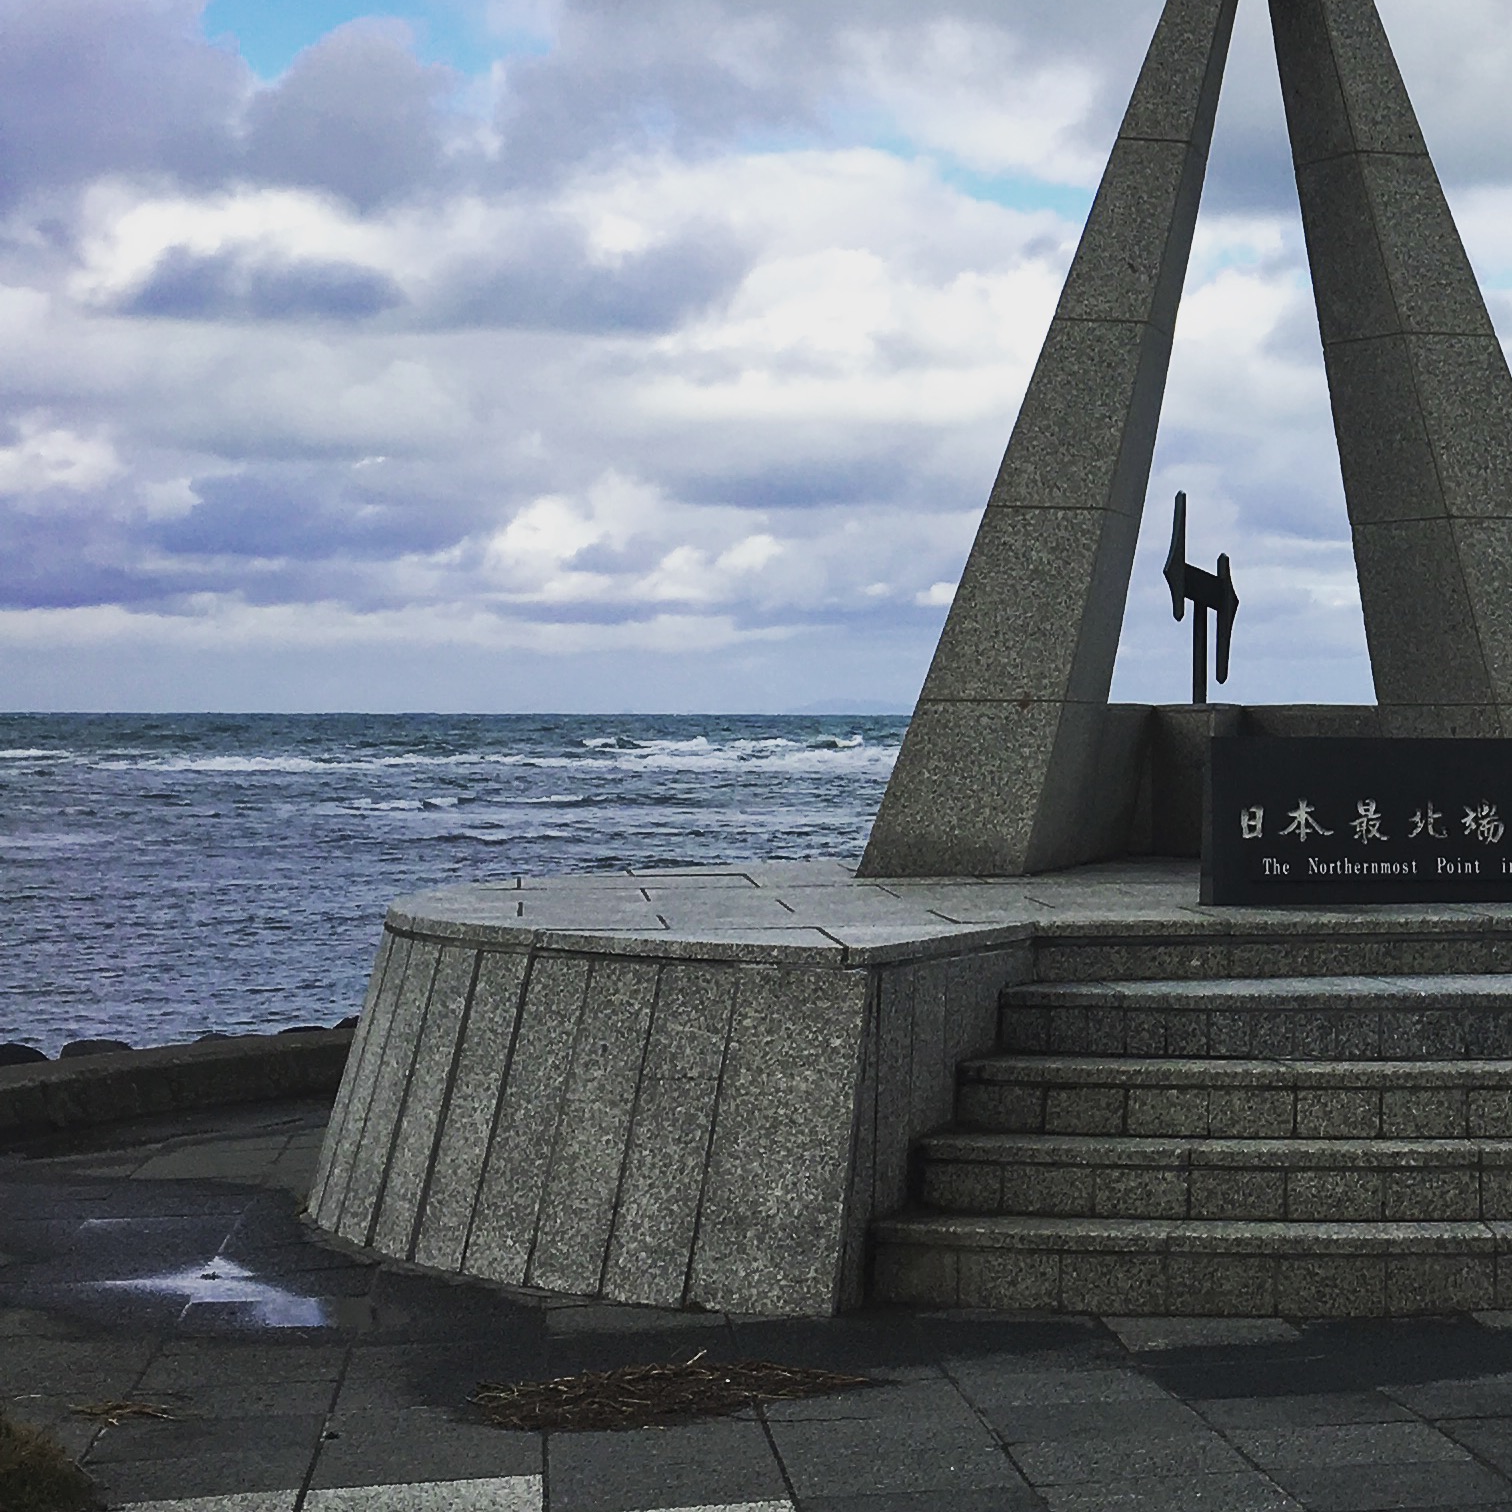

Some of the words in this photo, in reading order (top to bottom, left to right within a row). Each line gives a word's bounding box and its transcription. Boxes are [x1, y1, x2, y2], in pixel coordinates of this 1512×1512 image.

[1262, 856, 1291, 875] The
[1308, 856, 1418, 875] Northernmost
[1436, 856, 1481, 875] Point
